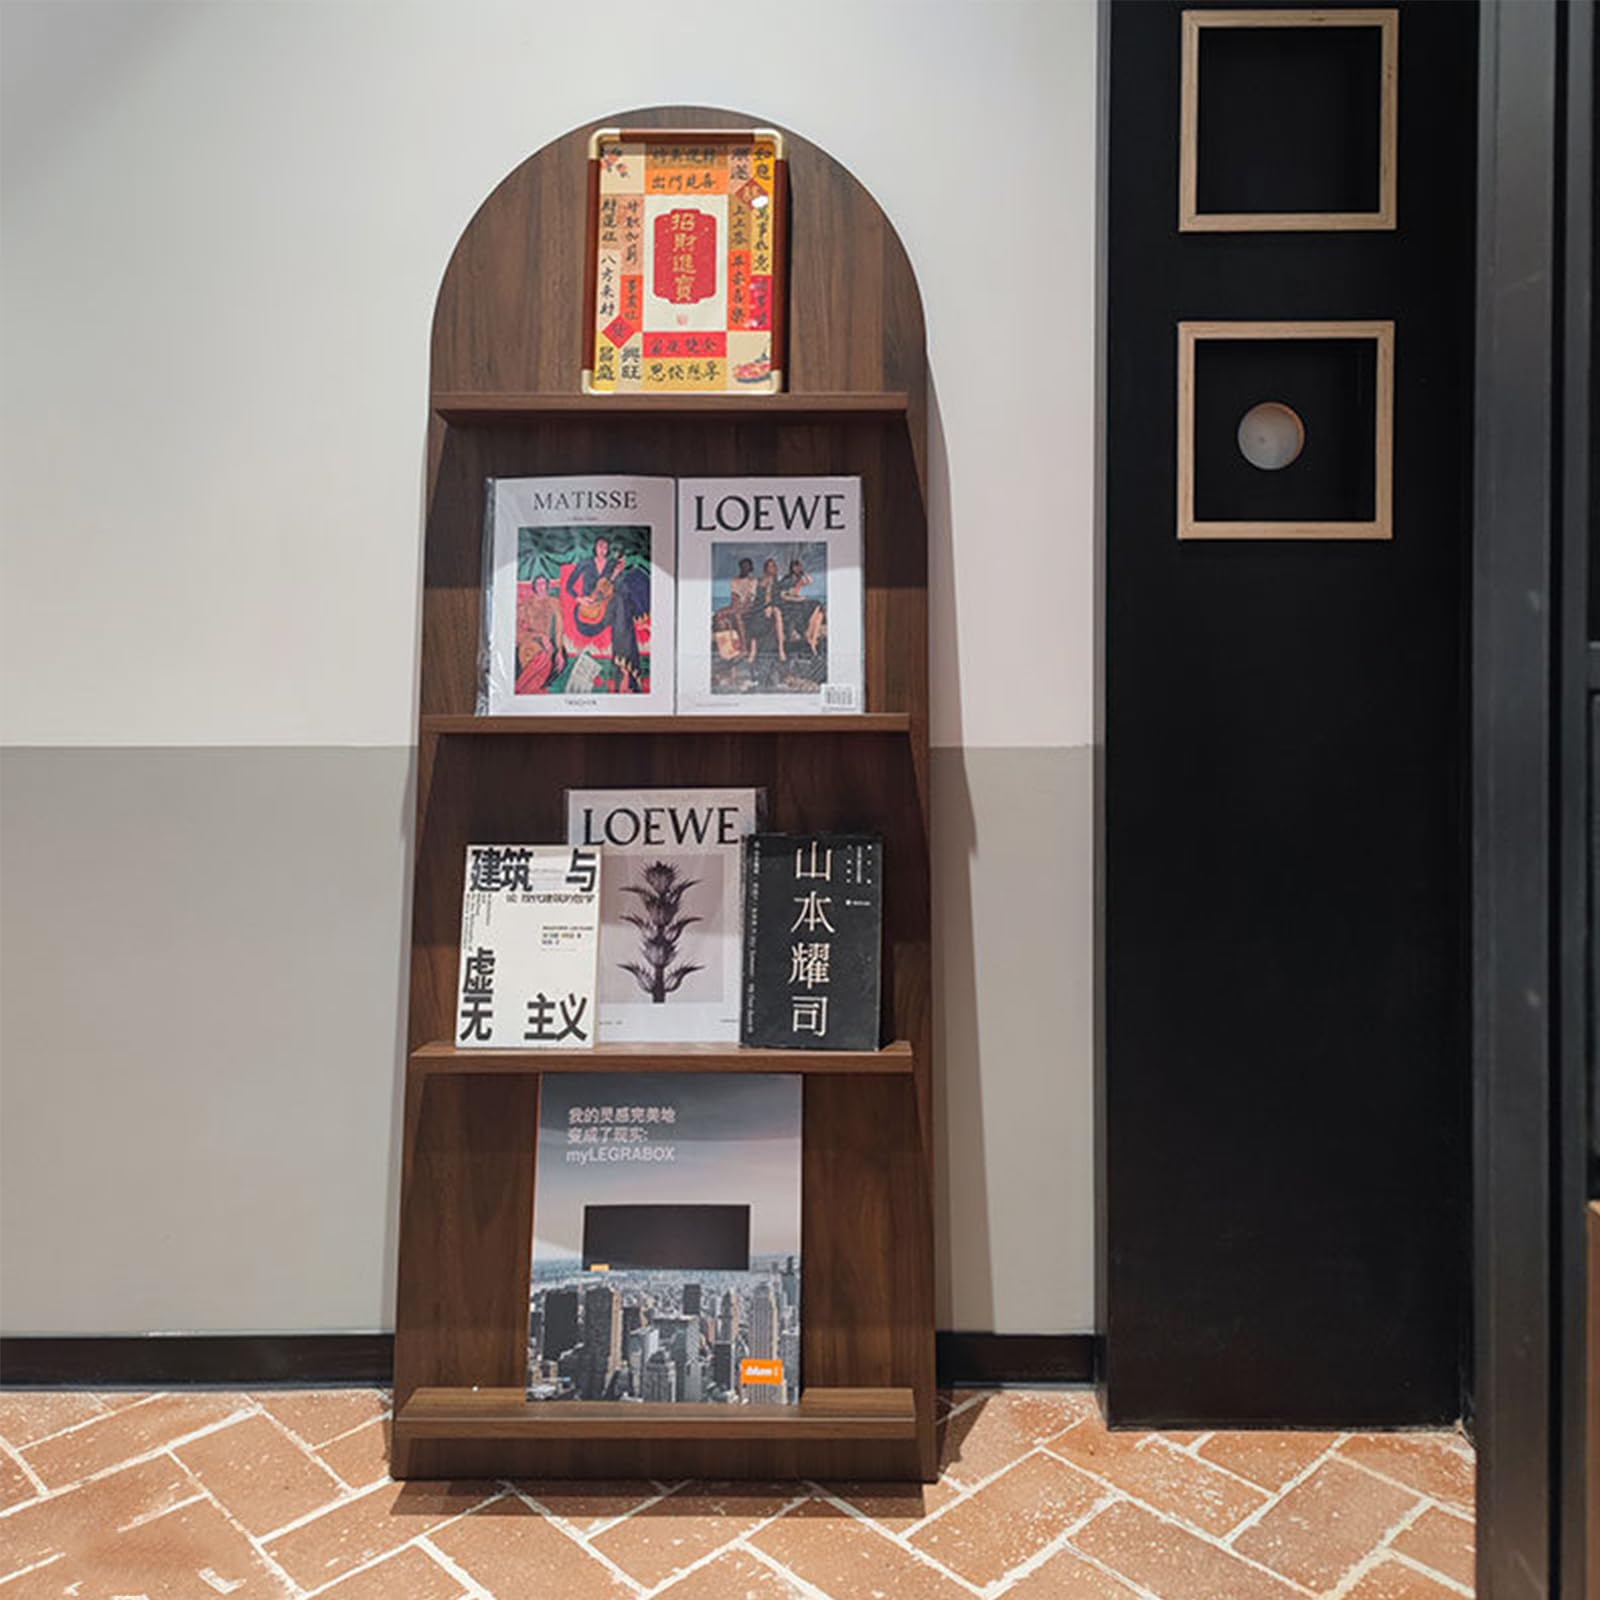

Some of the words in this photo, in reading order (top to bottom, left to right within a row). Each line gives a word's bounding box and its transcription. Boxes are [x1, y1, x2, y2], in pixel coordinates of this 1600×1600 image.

[671, 213, 697, 301] 招財進寶
[533, 491, 638, 511] MATISSE
[695, 495, 846, 531] LOEWE
[583, 808, 739, 845] LOEWE
[470, 848, 533, 892] 建筑
[566, 848, 596, 892] 与
[787, 841, 836, 1037] 山本耀司
[524, 993, 587, 1041] 主义
[566, 1147, 676, 1165] myLEGRABOX
